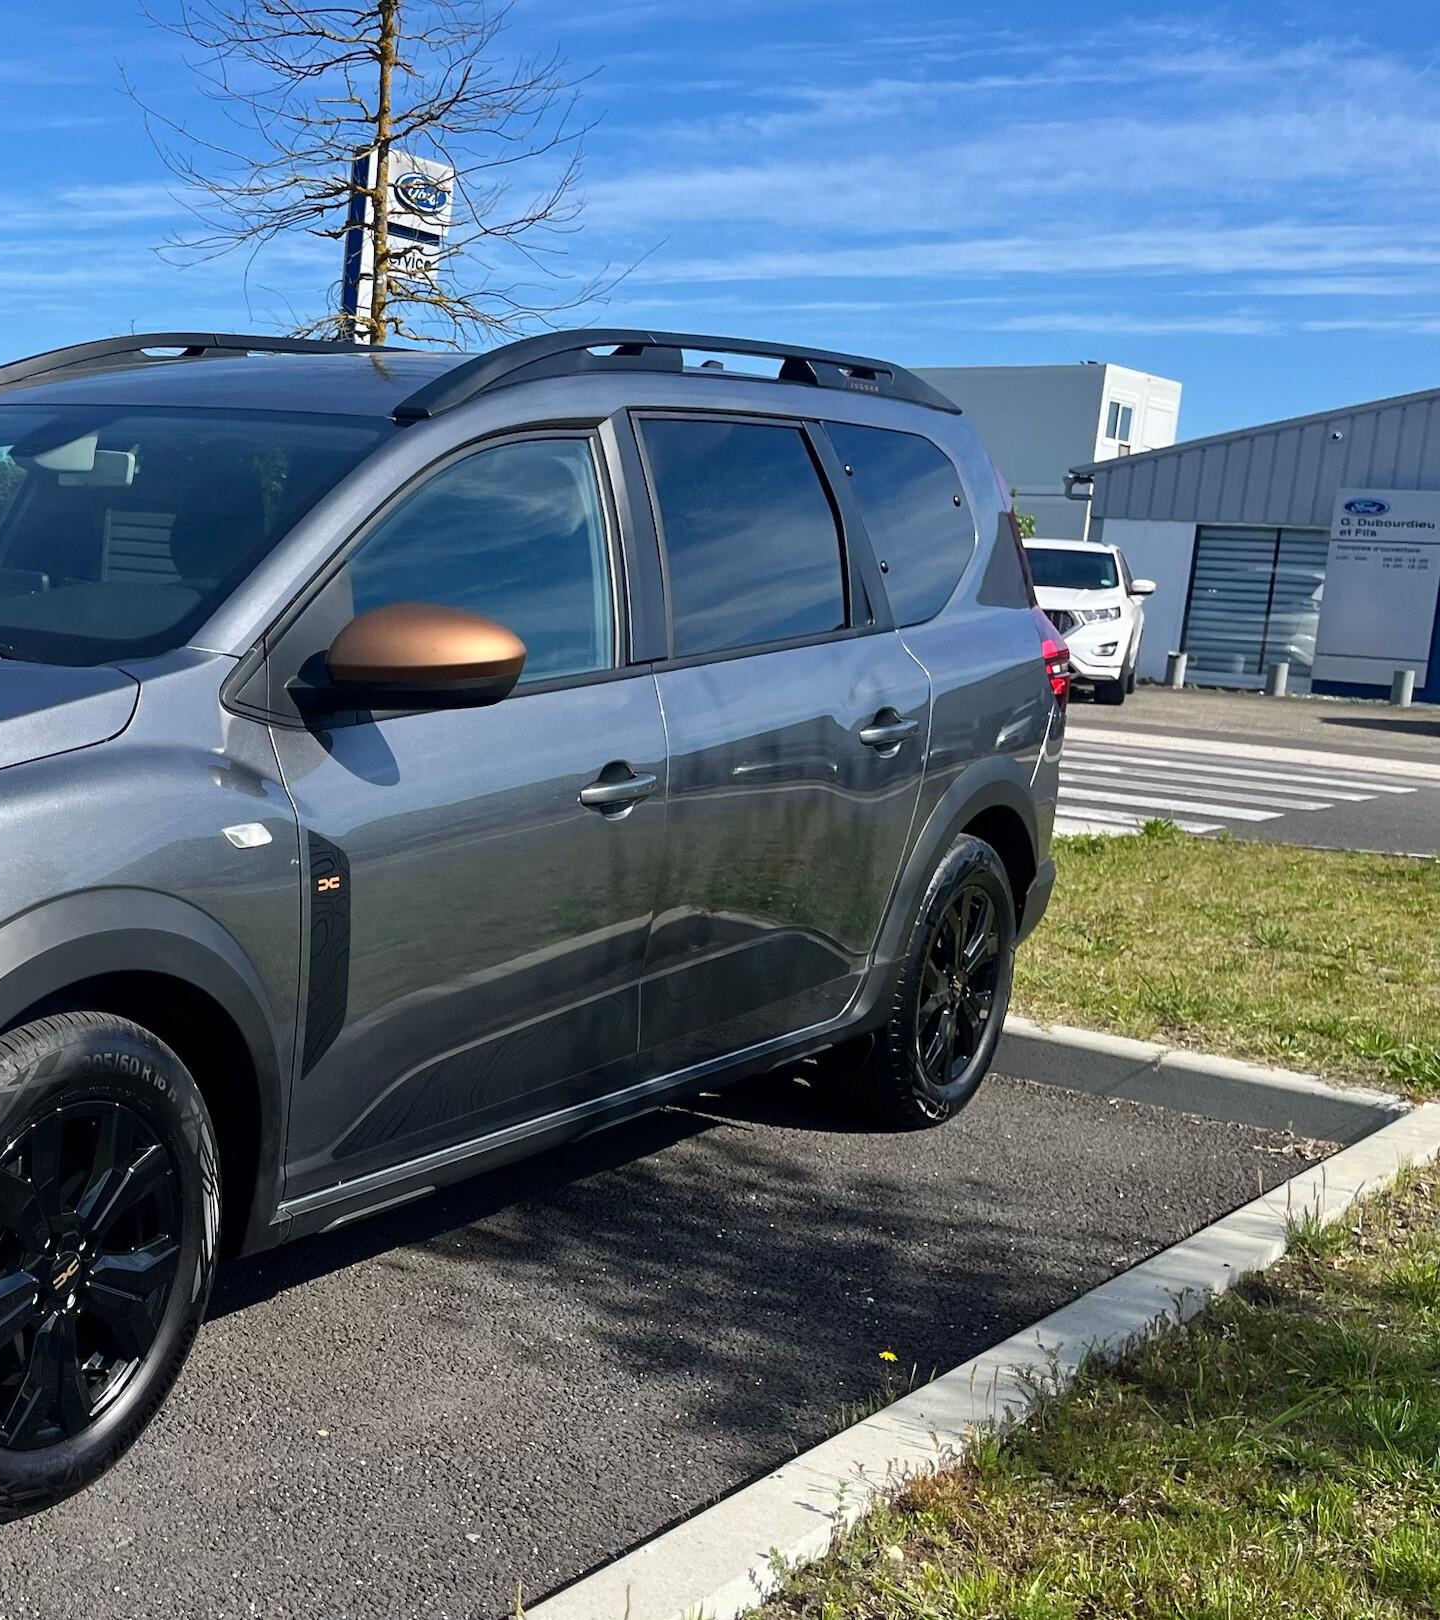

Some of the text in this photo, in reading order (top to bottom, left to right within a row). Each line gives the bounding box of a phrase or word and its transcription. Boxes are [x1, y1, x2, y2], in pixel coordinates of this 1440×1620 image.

[1357, 518, 1436, 530] Dubourdieu
[1339, 528, 1352, 537] et
[141, 1062, 153, 1082] R
